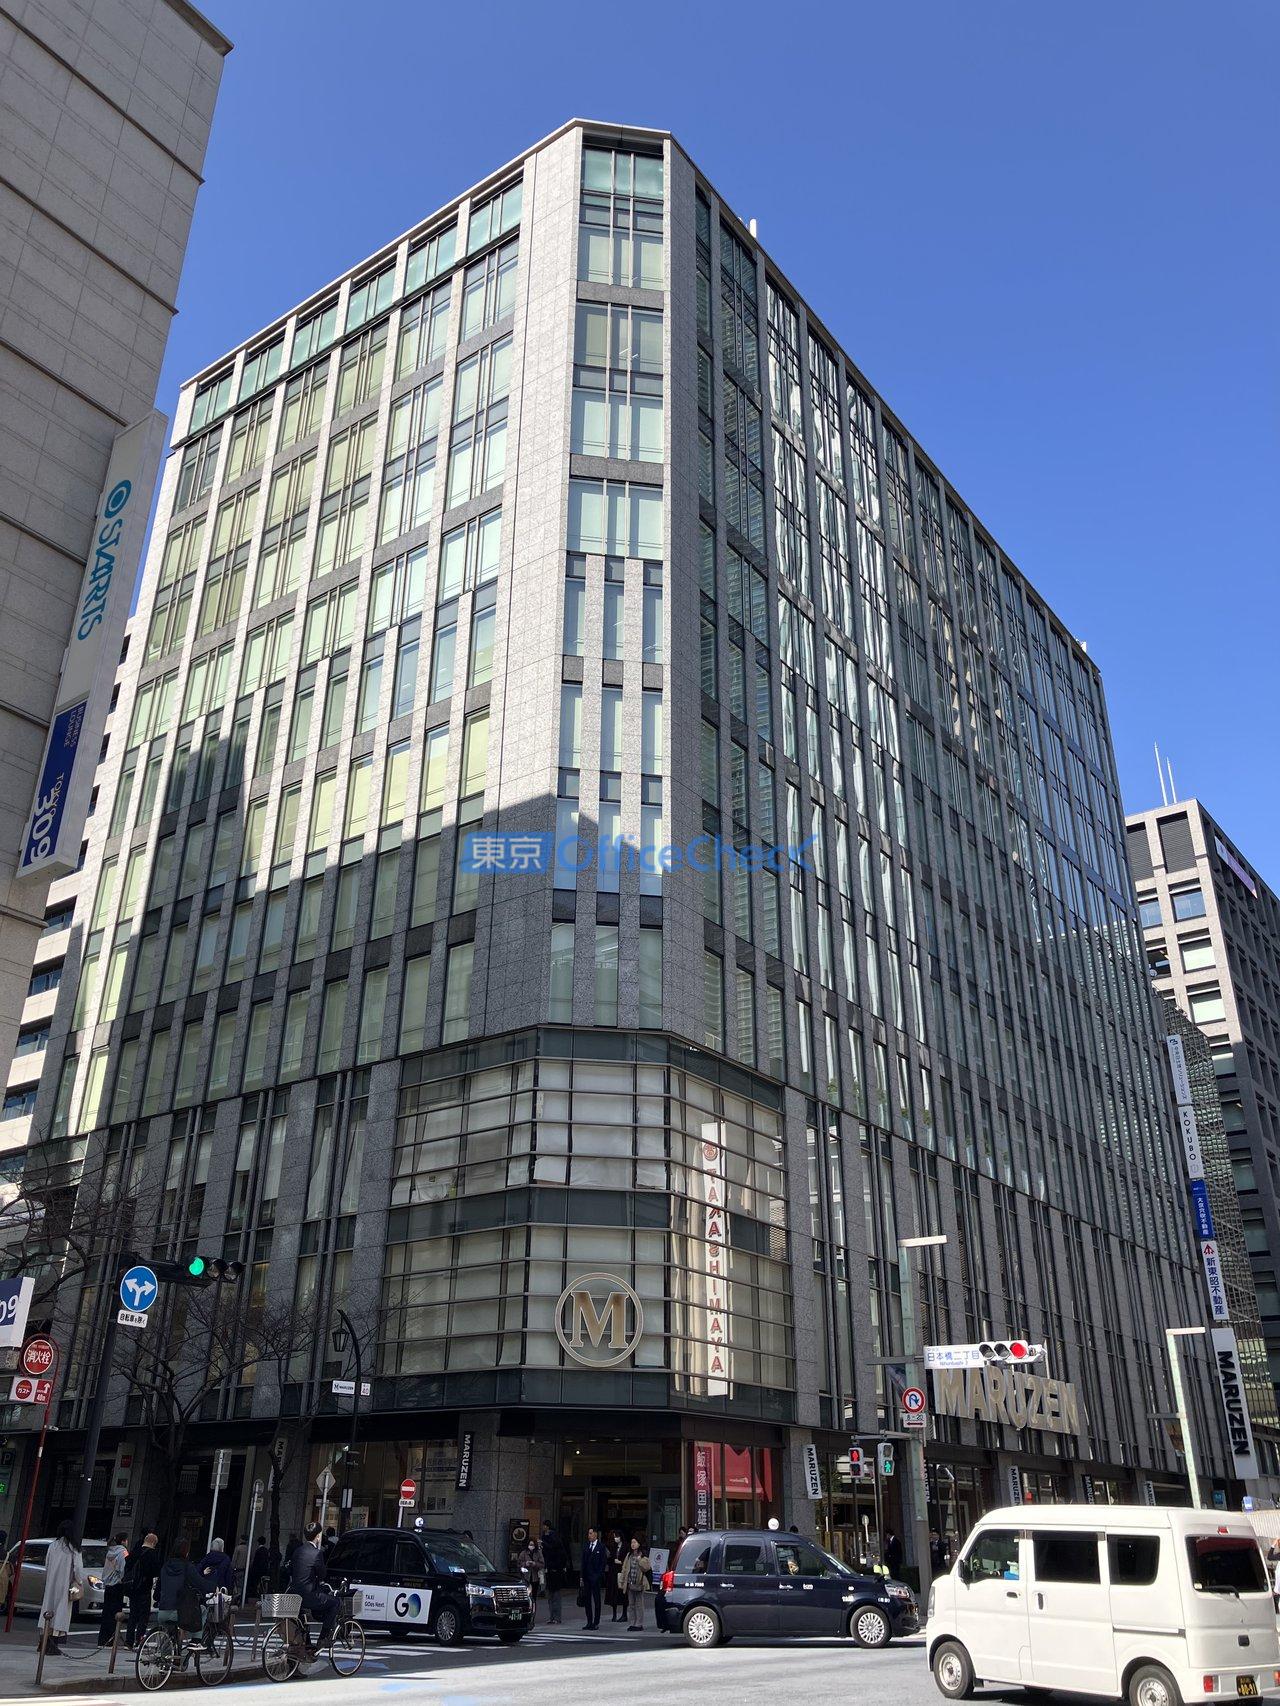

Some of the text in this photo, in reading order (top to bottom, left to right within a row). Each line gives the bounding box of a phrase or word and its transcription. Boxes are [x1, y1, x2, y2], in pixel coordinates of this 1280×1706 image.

[49, 771, 65, 816] TOKYO
[30, 787, 56, 864] 309
[1183, 1111, 1197, 1160] KOKUBO
[704, 1168, 724, 1373] TAKASHIMAYA
[1206, 1257, 1225, 1315] 新東昭不動産
[26, 1349, 51, 1365] 消火栓
[927, 1350, 980, 1362] 日本橋二丁目
[933, 1365, 1081, 1436] MARUZEN
[1217, 1351, 1250, 1456] MARUZEN
[459, 1434, 471, 1487] MARUZEN
[807, 1447, 819, 1495] MARUZEN
[394, 1592, 422, 1619] GO
